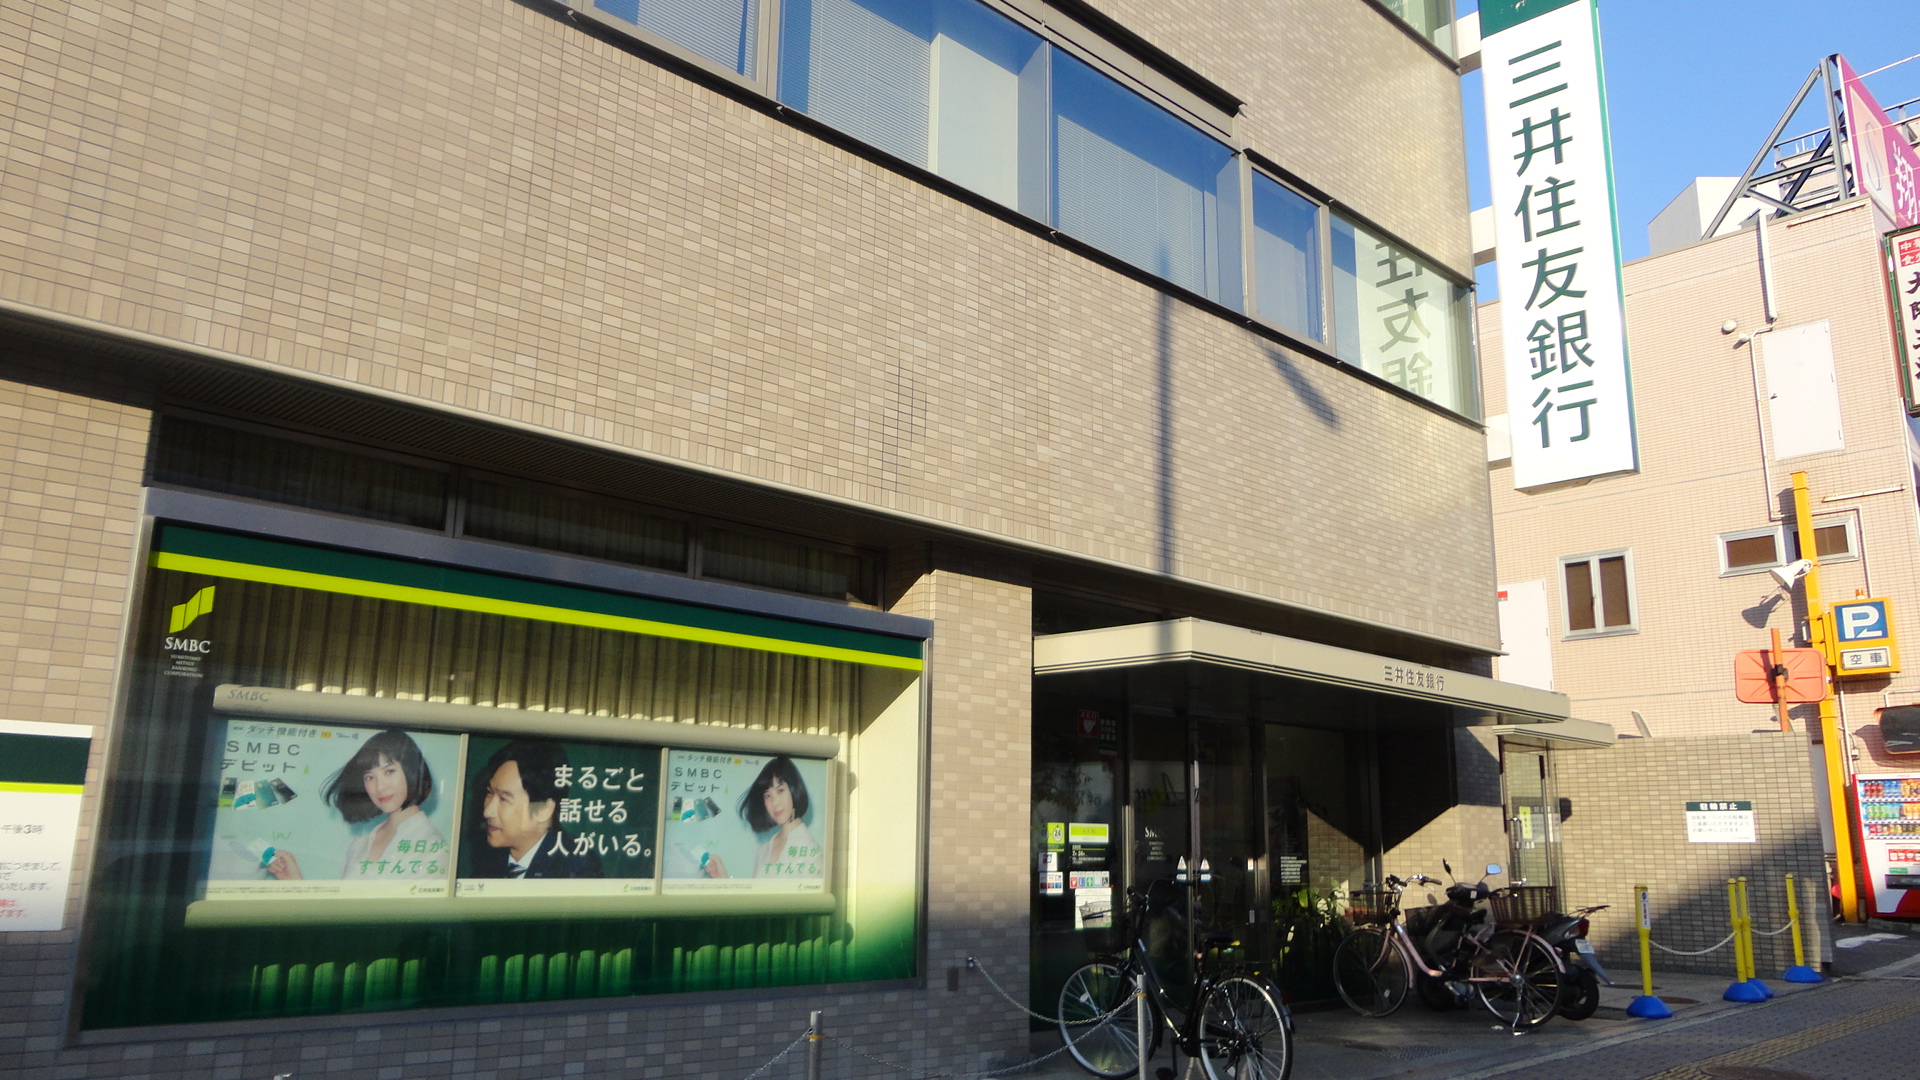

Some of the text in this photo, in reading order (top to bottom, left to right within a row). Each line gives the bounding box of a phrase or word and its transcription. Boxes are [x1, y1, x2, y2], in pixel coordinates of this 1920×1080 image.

[1508, 40, 1598, 449] 三井住友銀行
[1842, 605, 1880, 639] P
[164, 636, 211, 653] SMBC
[1850, 652, 1883, 665] 空車
[1384, 665, 1444, 691] 三井住友銀行
[228, 689, 271, 701] SMBC
[246, 725, 318, 738] タッチ機能付き
[226, 740, 301, 756] SMBC
[220, 758, 297, 773] デビット
[674, 767, 723, 779] SMBC
[554, 764, 645, 791] まるごと
[670, 781, 721, 794] デビット
[559, 798, 628, 823] 話せる
[397, 839, 449, 854] 毎日が、
[547, 831, 652, 857] 人がいる。
[0, 862, 61, 871] につきまして、
[359, 859, 446, 875] すすんでる。
[763, 862, 821, 875] すすんでる。
